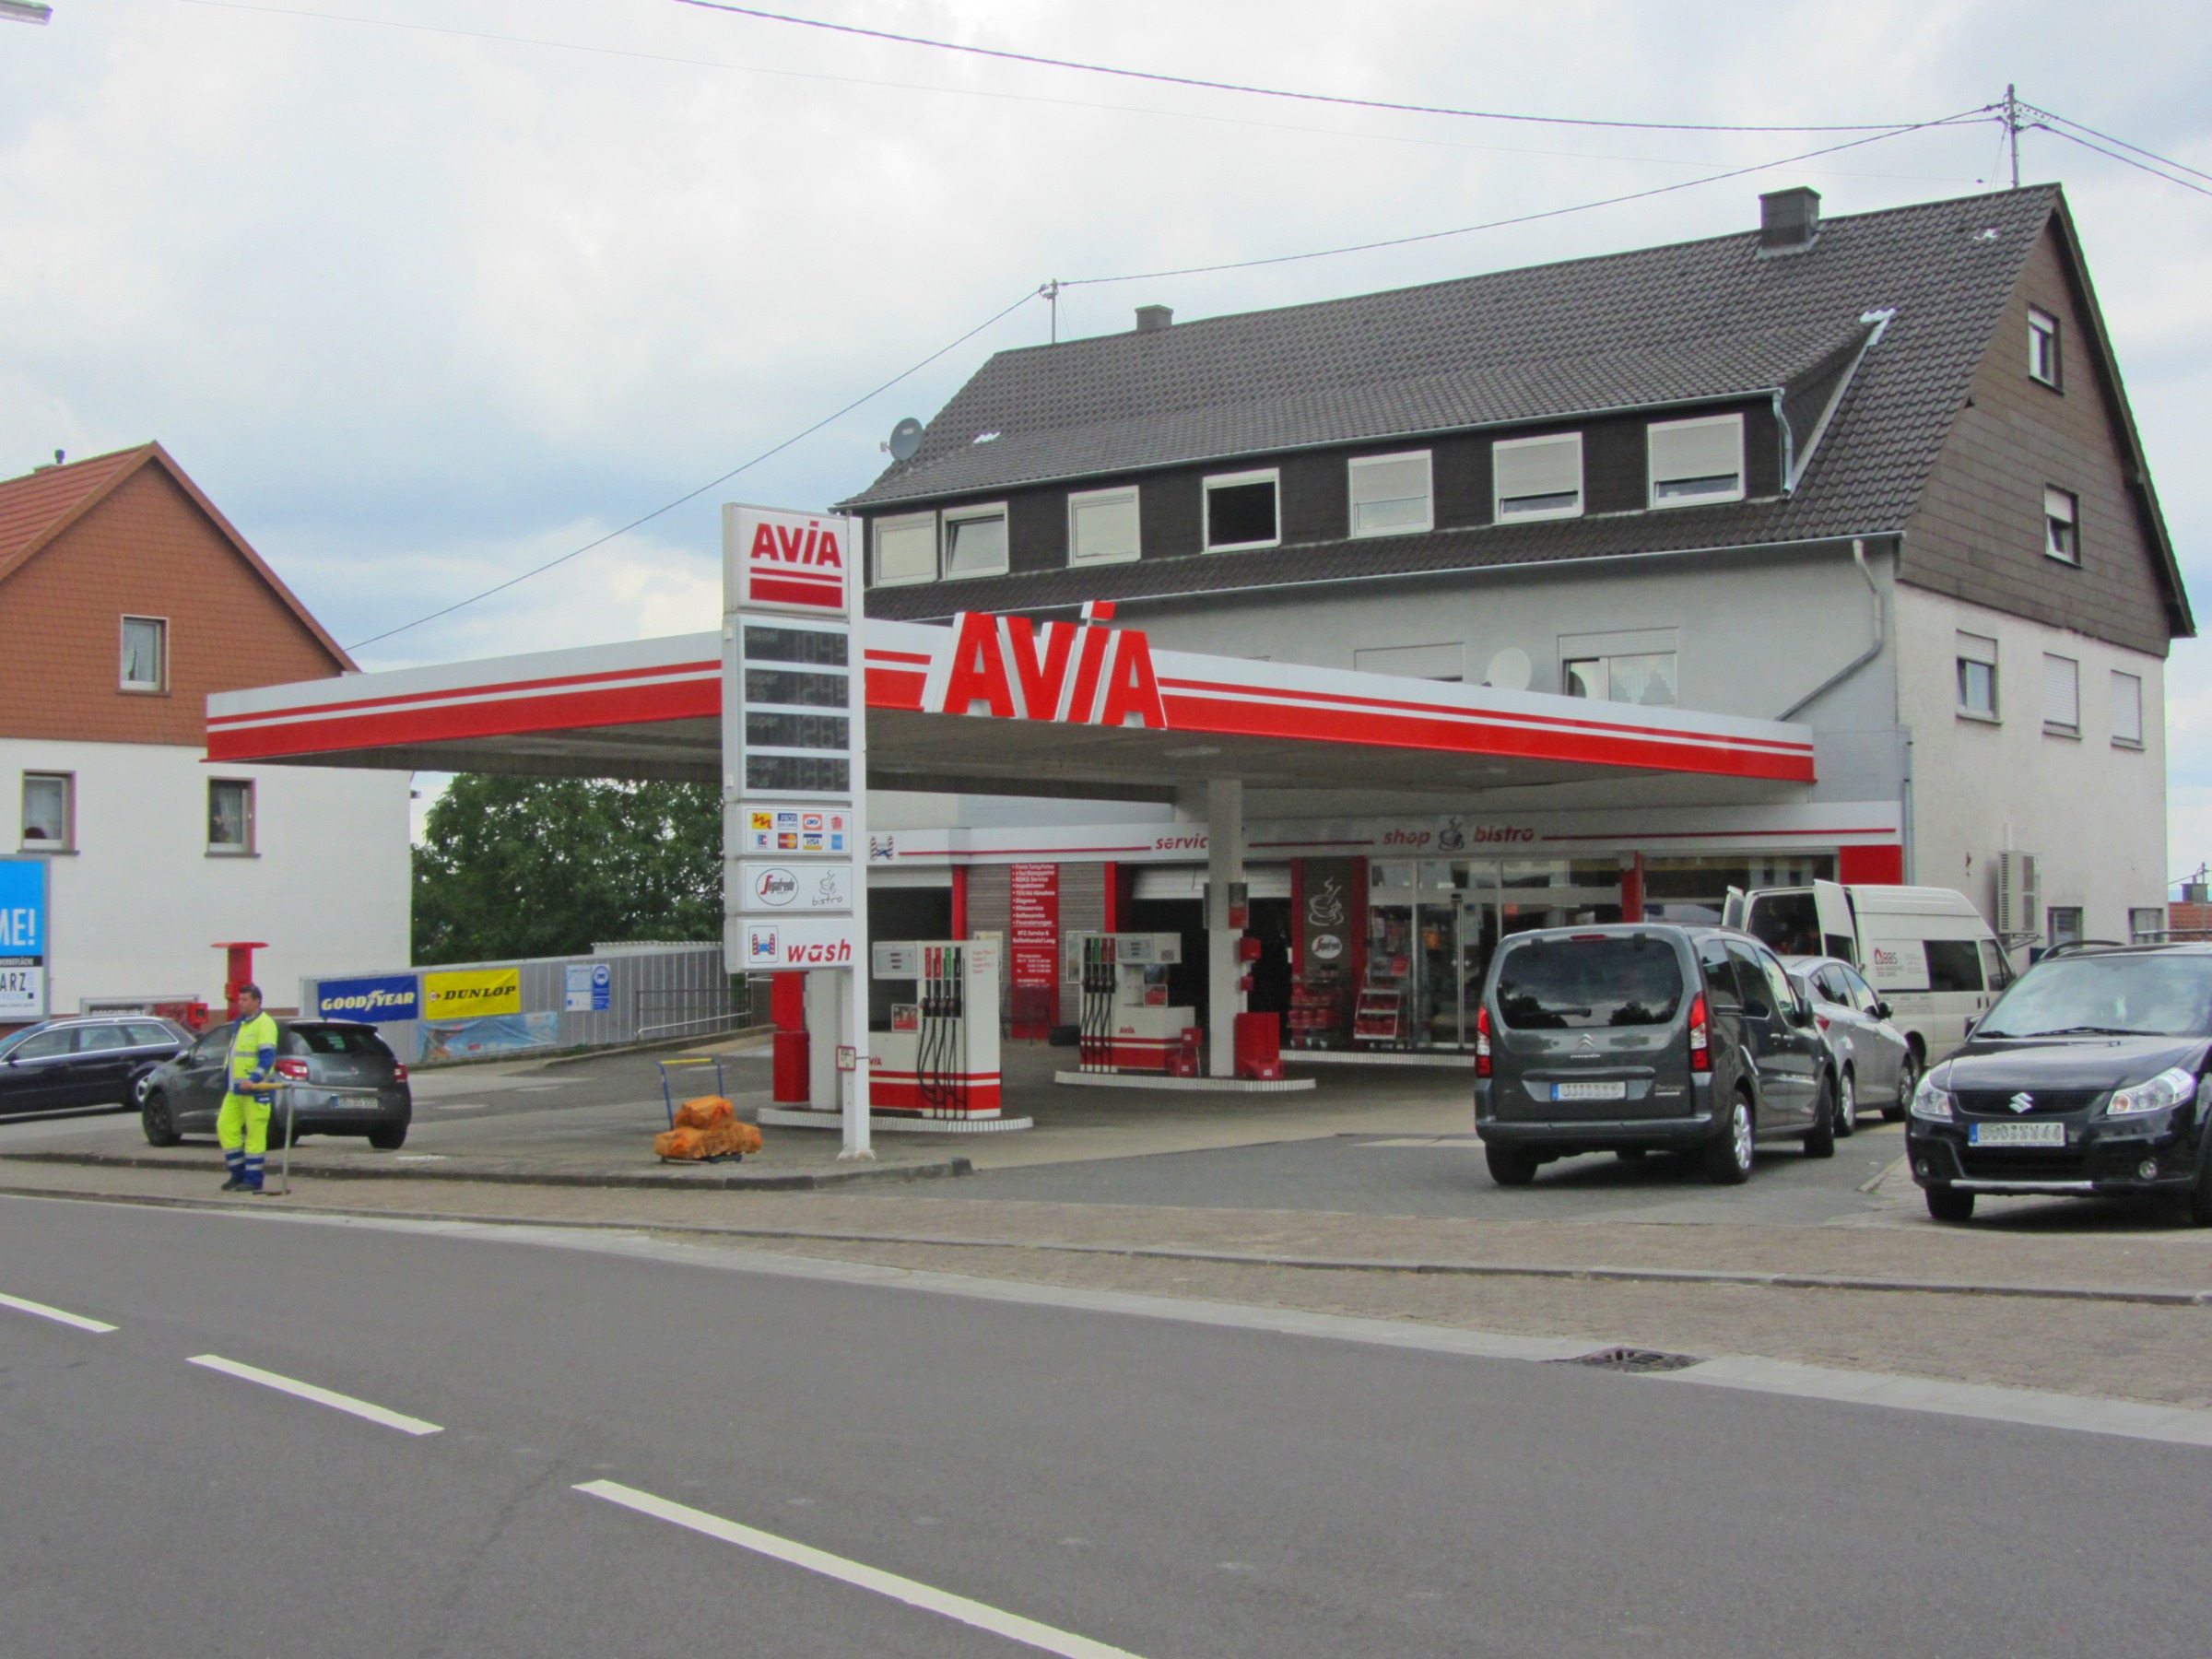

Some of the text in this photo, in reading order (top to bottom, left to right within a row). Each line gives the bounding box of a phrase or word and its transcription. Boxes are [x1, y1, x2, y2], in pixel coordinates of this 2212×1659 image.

[1156, 833, 1209, 852] servic
[1383, 828, 1431, 848] shop
[1474, 826, 1535, 844] bistro
[812, 894, 843, 907] bistro
[787, 938, 852, 963] wash
[321, 990, 415, 1012] GOODYEAR
[443, 984, 517, 1001] DUNLOP
[868, 1055, 883, 1066] VIA
